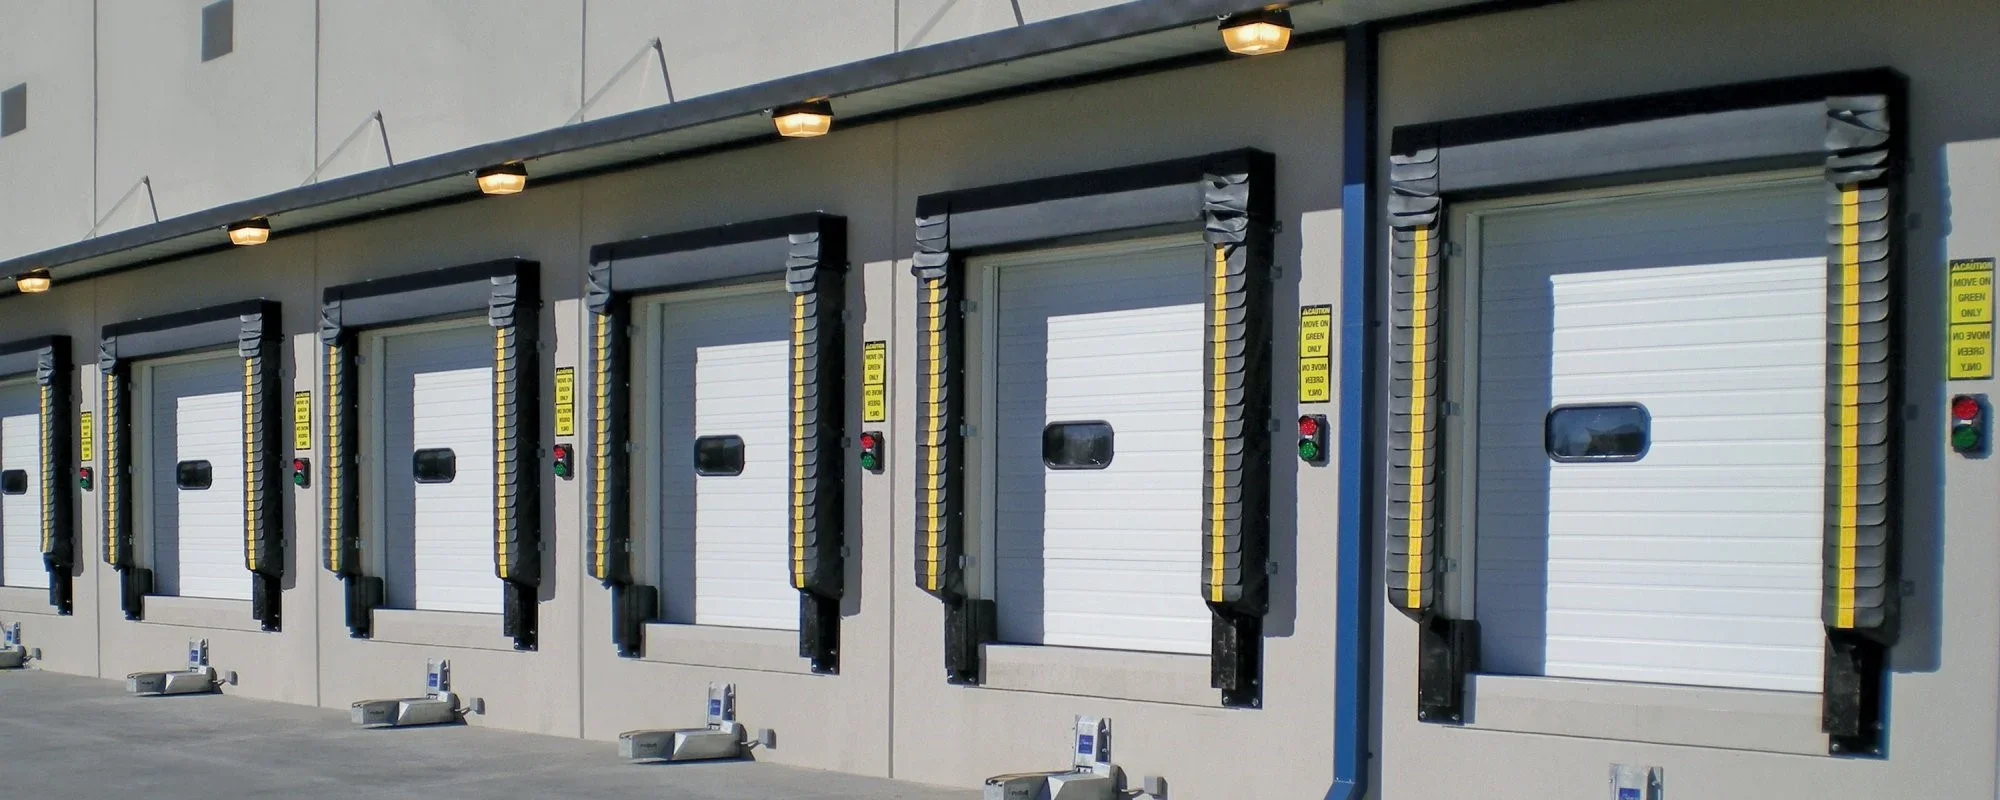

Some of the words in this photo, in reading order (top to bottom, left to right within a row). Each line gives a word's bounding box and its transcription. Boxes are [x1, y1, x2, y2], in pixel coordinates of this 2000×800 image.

[1960, 262, 1992, 270] CAUTION
[1953, 278, 1977, 287] MOVE
[1979, 277, 1991, 286] ON
[1958, 293, 1985, 302] GREEN
[1961, 308, 1982, 318] ONLY
[1306, 332, 1324, 341] GREEN
[1308, 345, 1321, 353] ONLY
